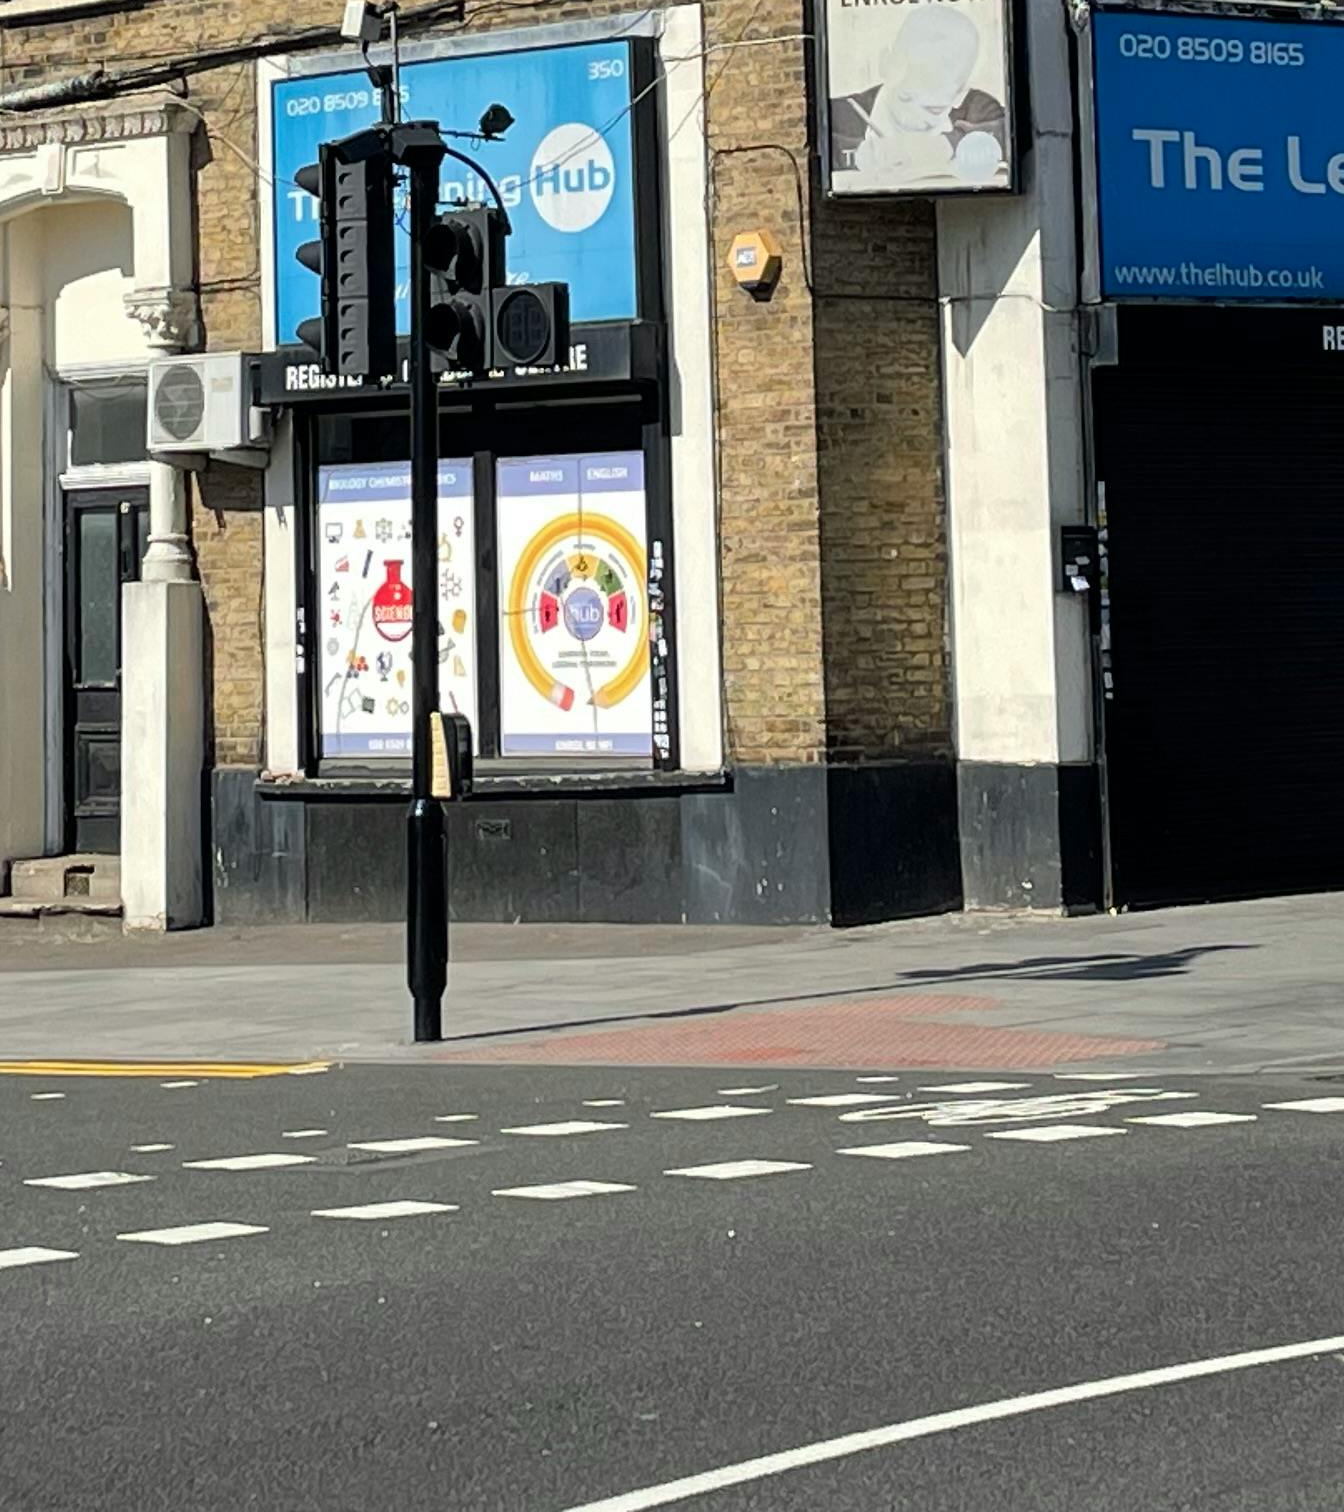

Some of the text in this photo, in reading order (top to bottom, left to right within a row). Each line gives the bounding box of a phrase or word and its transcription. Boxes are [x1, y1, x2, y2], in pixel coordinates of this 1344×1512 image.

[1119, 33, 1305, 66] 020 8509 8165
[587, 59, 624, 80] 350
[286, 84, 411, 117] 020 8509 85
[1132, 129, 1265, 192] The
[535, 159, 612, 197] Hub
[1115, 261, 1325, 289] www.thelhub.co.uk
